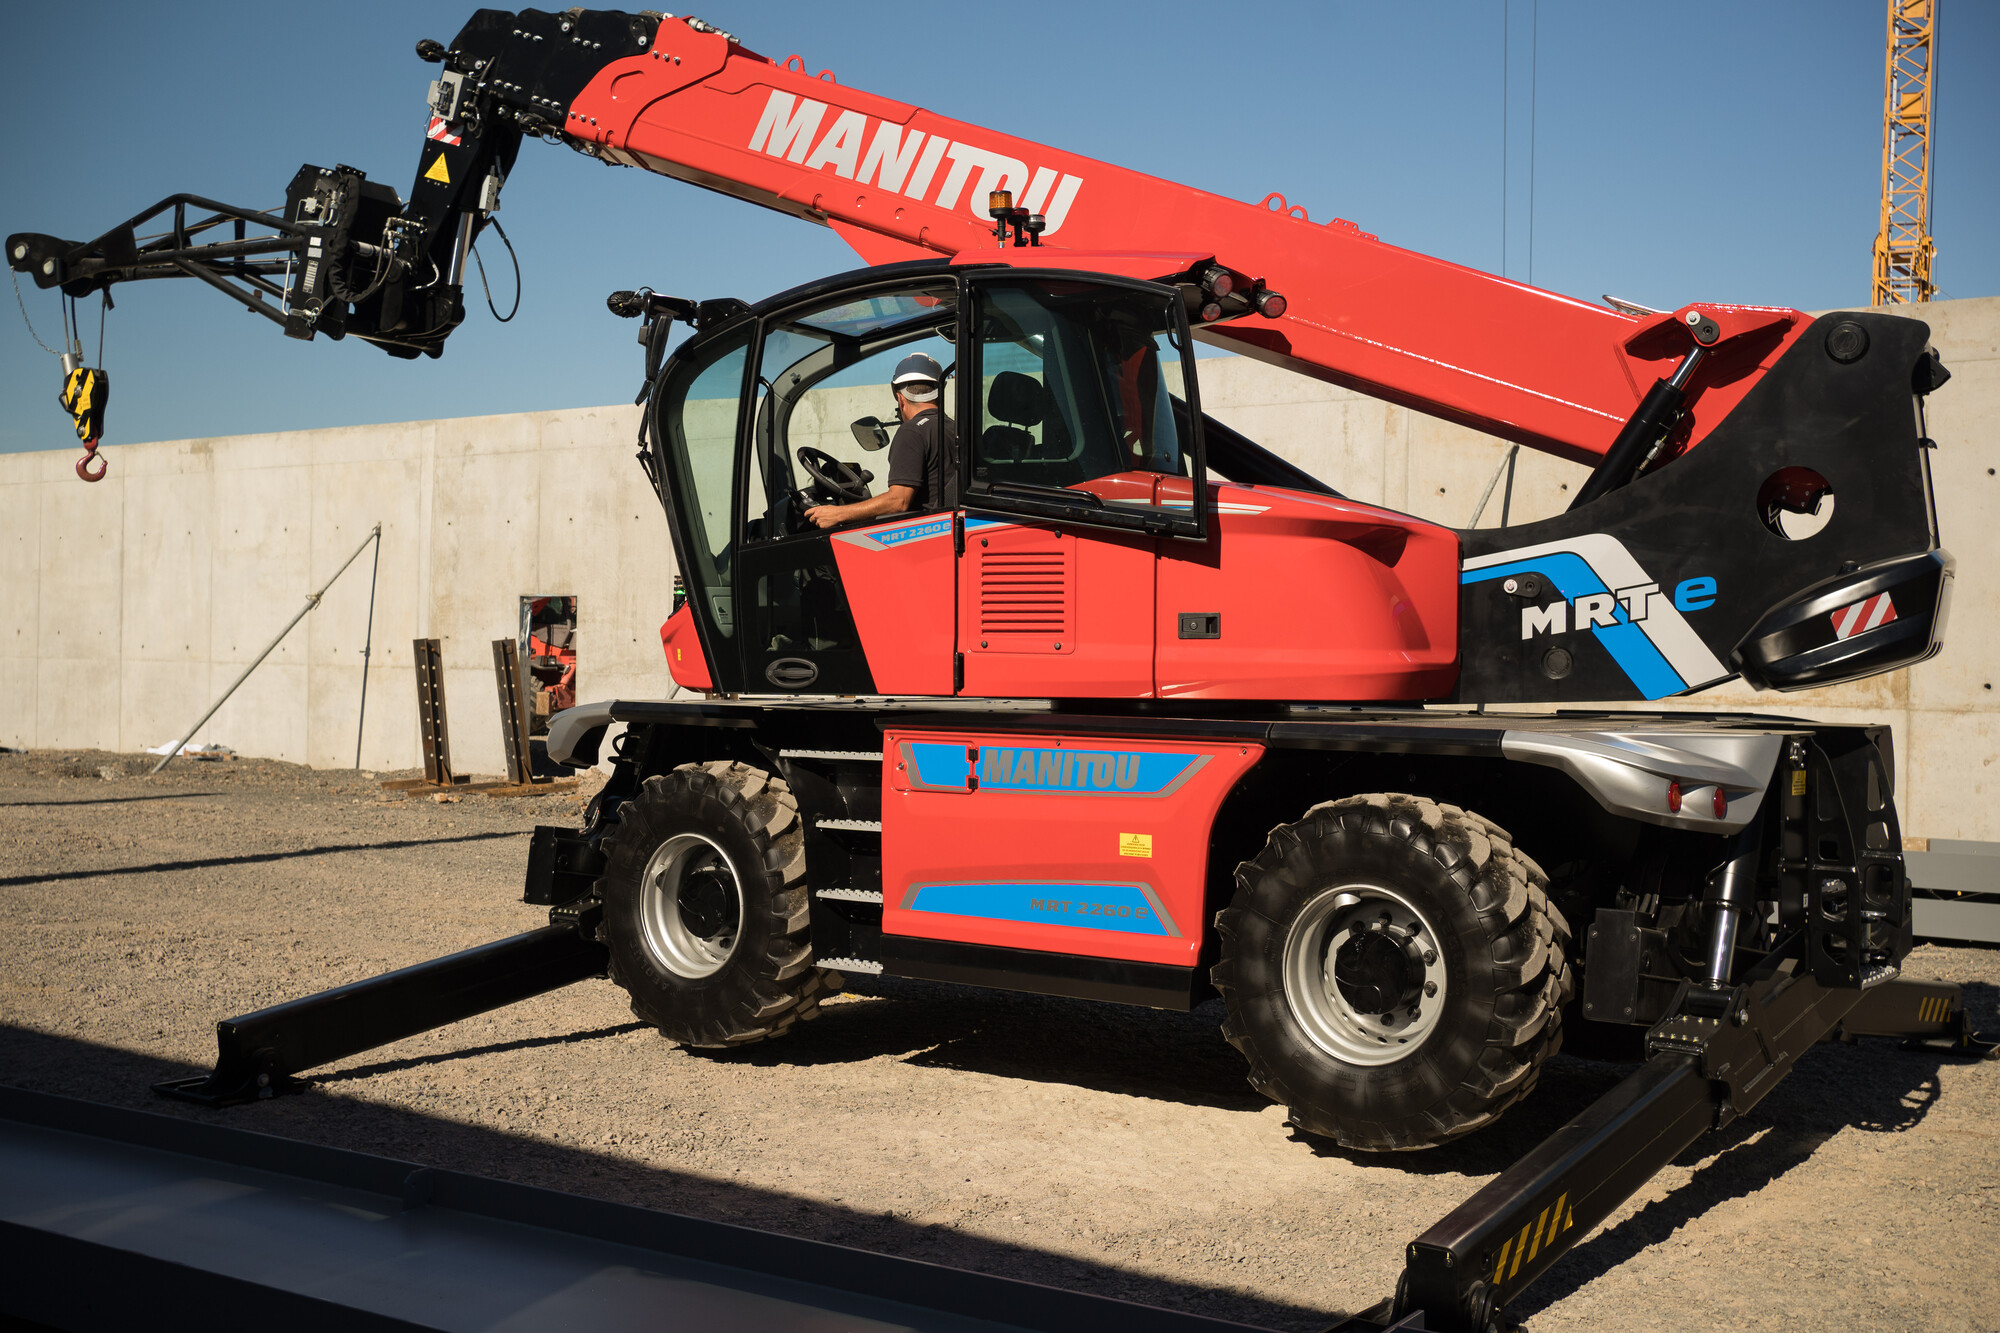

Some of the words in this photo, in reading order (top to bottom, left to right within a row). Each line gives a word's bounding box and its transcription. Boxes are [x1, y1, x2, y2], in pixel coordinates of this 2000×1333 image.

[747, 89, 1084, 237] MANITOU
[881, 531, 907, 543] MRT
[1522, 583, 1660, 641] MRT
[1674, 576, 1718, 612] e
[982, 749, 1141, 790] MANITOU
[1030, 898, 1073, 913] MRT
[1076, 902, 1131, 918] 2260
